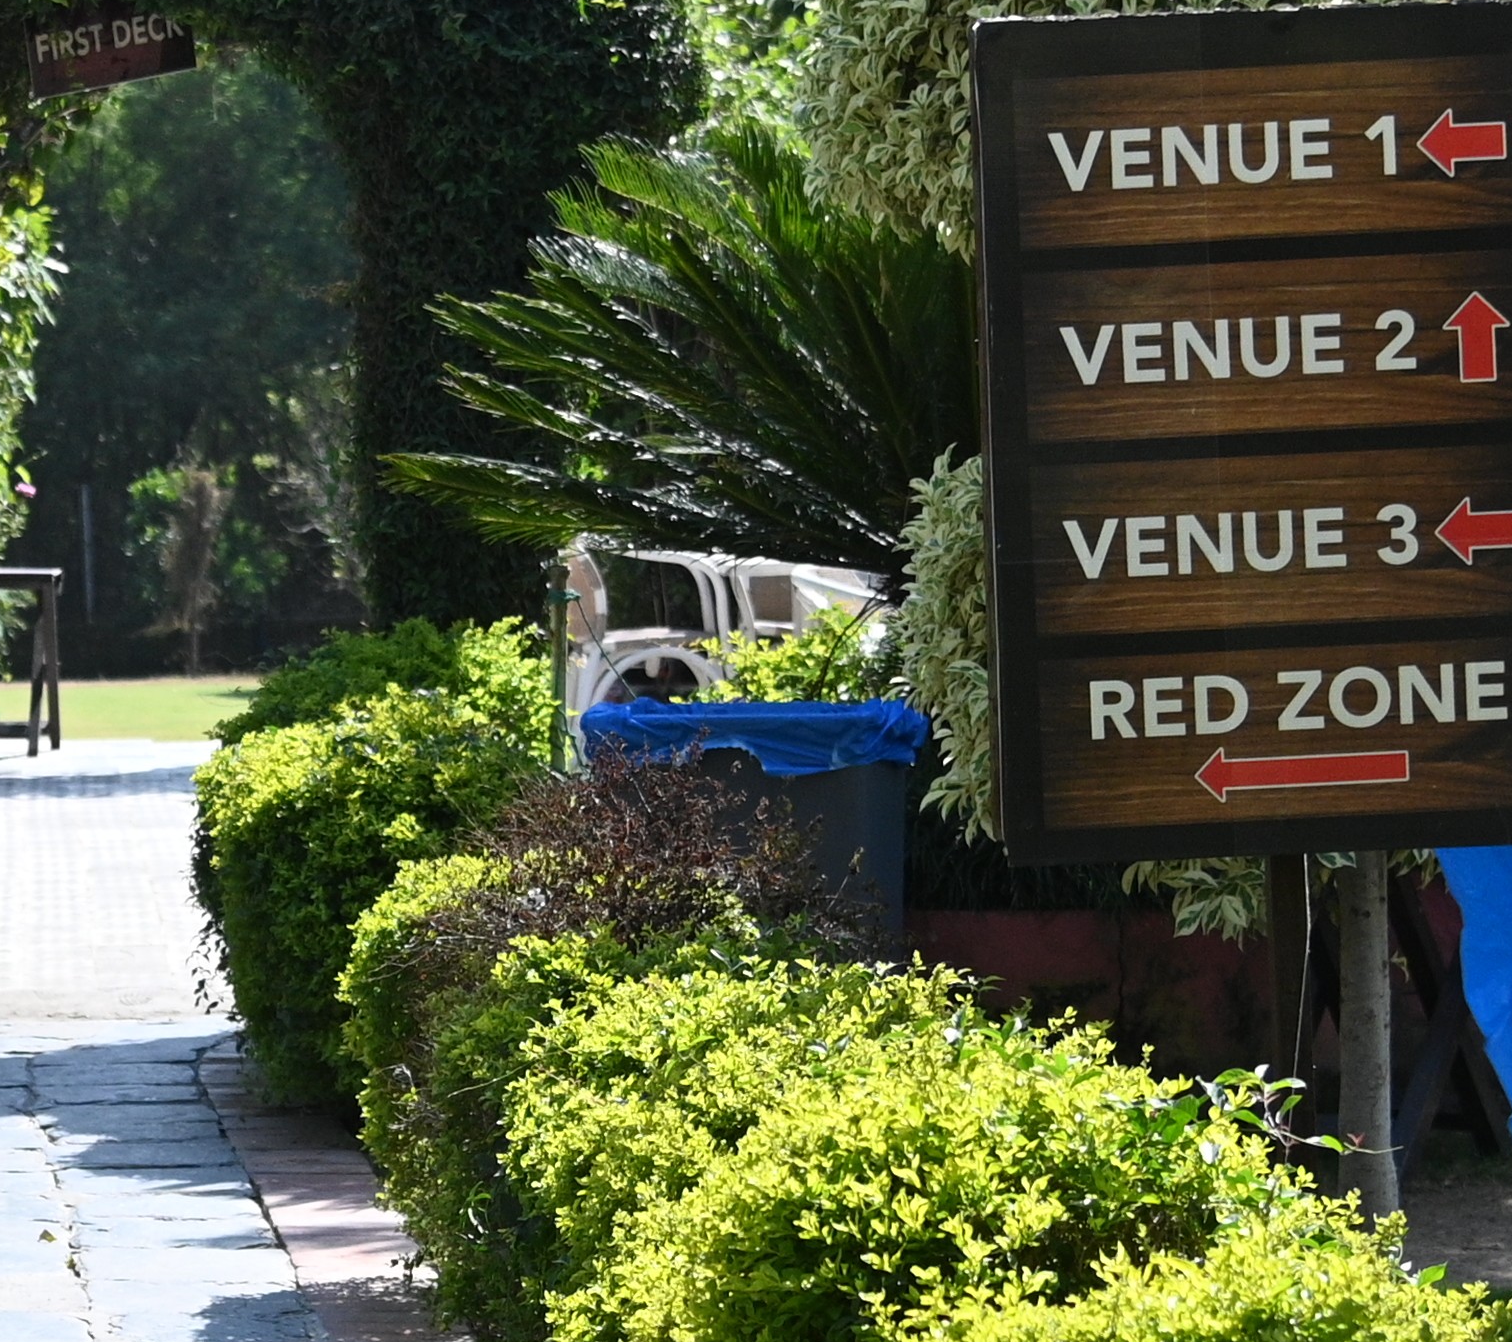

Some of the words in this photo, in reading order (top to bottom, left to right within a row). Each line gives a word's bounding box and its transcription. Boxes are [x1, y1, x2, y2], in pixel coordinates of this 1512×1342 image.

[35, 23, 103, 63] FIRST
[1048, 119, 1333, 193] VENUE
[1364, 115, 1399, 176] 1
[1060, 312, 1346, 386] VENUE
[1375, 310, 1417, 371] 2
[1063, 507, 1347, 580] VENUE
[1376, 504, 1418, 565] 3
[1089, 678, 1249, 740] RED
[1276, 662, 1508, 731] ZONE
